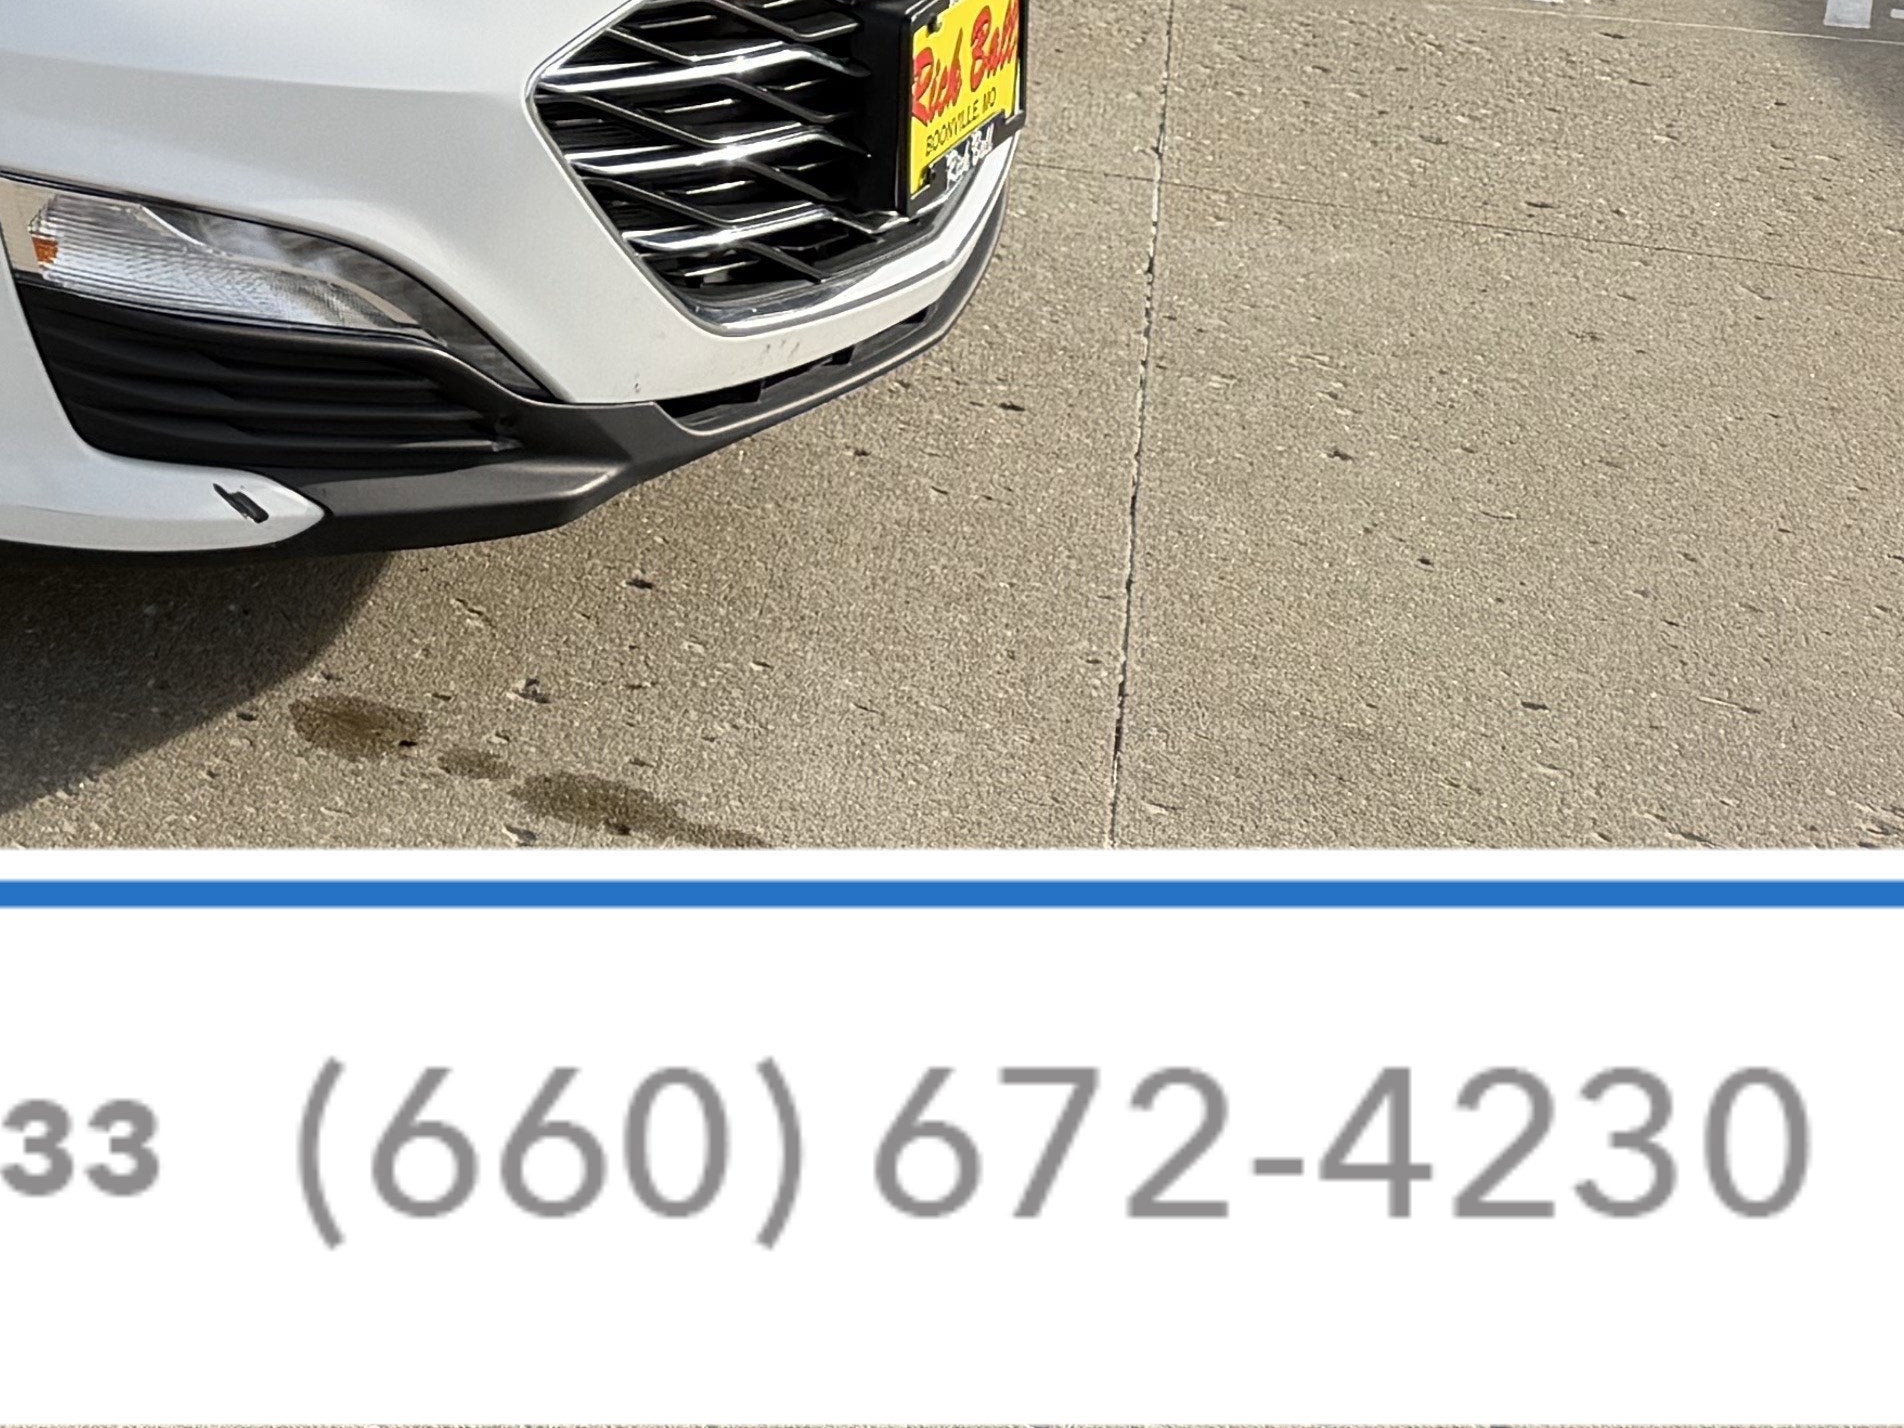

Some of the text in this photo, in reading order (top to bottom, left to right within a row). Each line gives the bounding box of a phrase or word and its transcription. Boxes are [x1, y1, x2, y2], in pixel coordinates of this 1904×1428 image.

[912, 27, 963, 127] Rick
[926, 87, 997, 157] BOONVILLE MO
